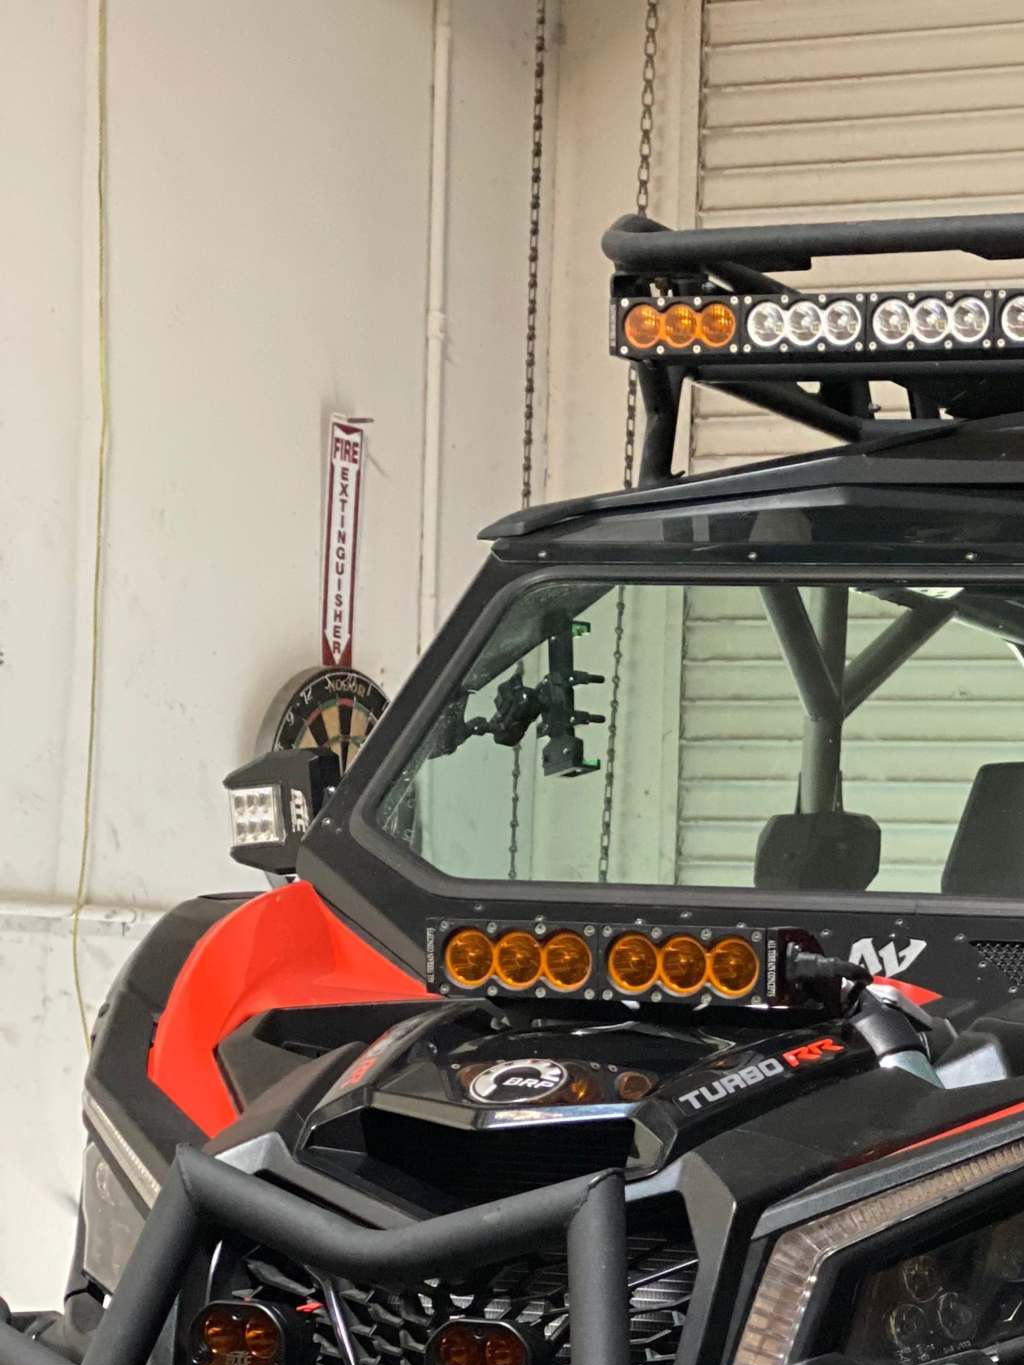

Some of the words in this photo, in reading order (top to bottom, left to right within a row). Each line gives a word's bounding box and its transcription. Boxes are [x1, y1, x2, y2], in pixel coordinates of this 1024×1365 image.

[333, 437, 359, 464] FIRE
[332, 467, 350, 654] EXTINGUISHER
[502, 1076, 555, 1089] BRP
[678, 1057, 784, 1110] TURBO
[782, 1038, 845, 1068] RR
